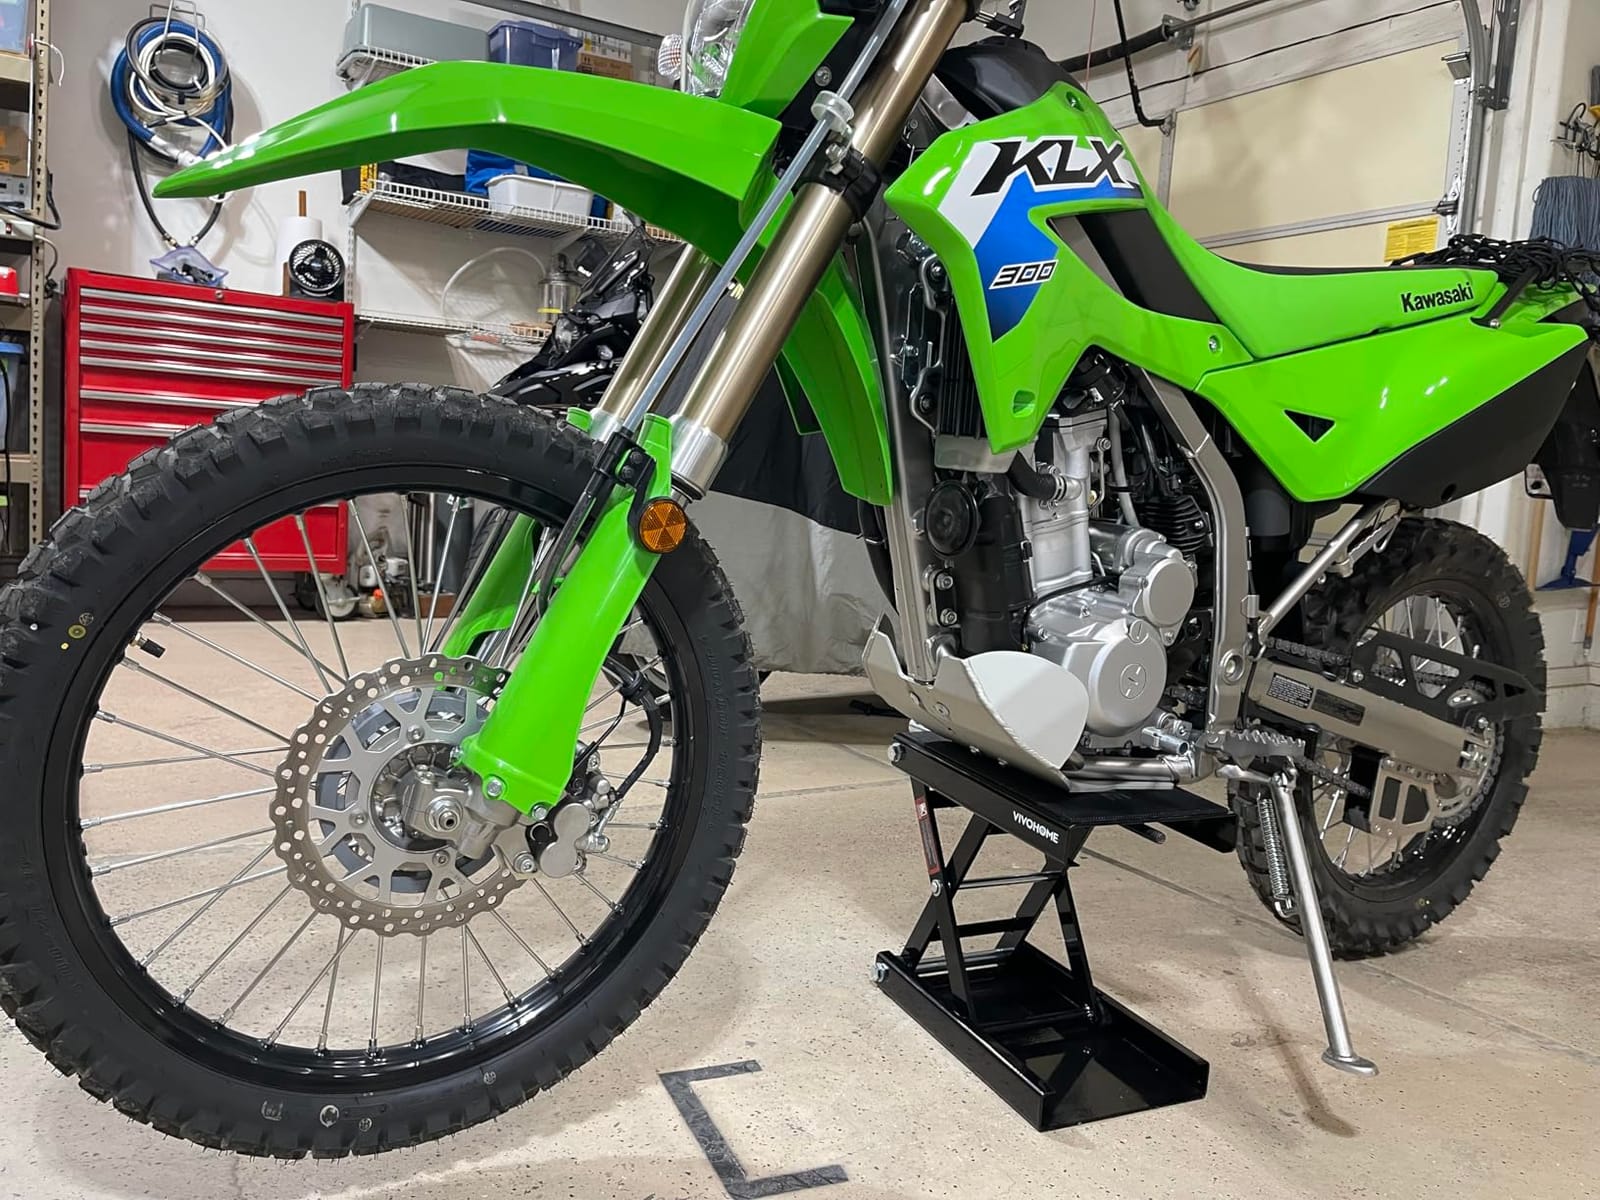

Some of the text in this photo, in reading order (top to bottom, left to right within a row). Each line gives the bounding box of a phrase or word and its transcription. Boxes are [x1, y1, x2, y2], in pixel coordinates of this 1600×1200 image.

[970, 137, 1129, 197] KLX
[990, 261, 1057, 288] 300
[1401, 282, 1474, 313] Kawasaki
[1013, 810, 1059, 844] VIVOHOME
